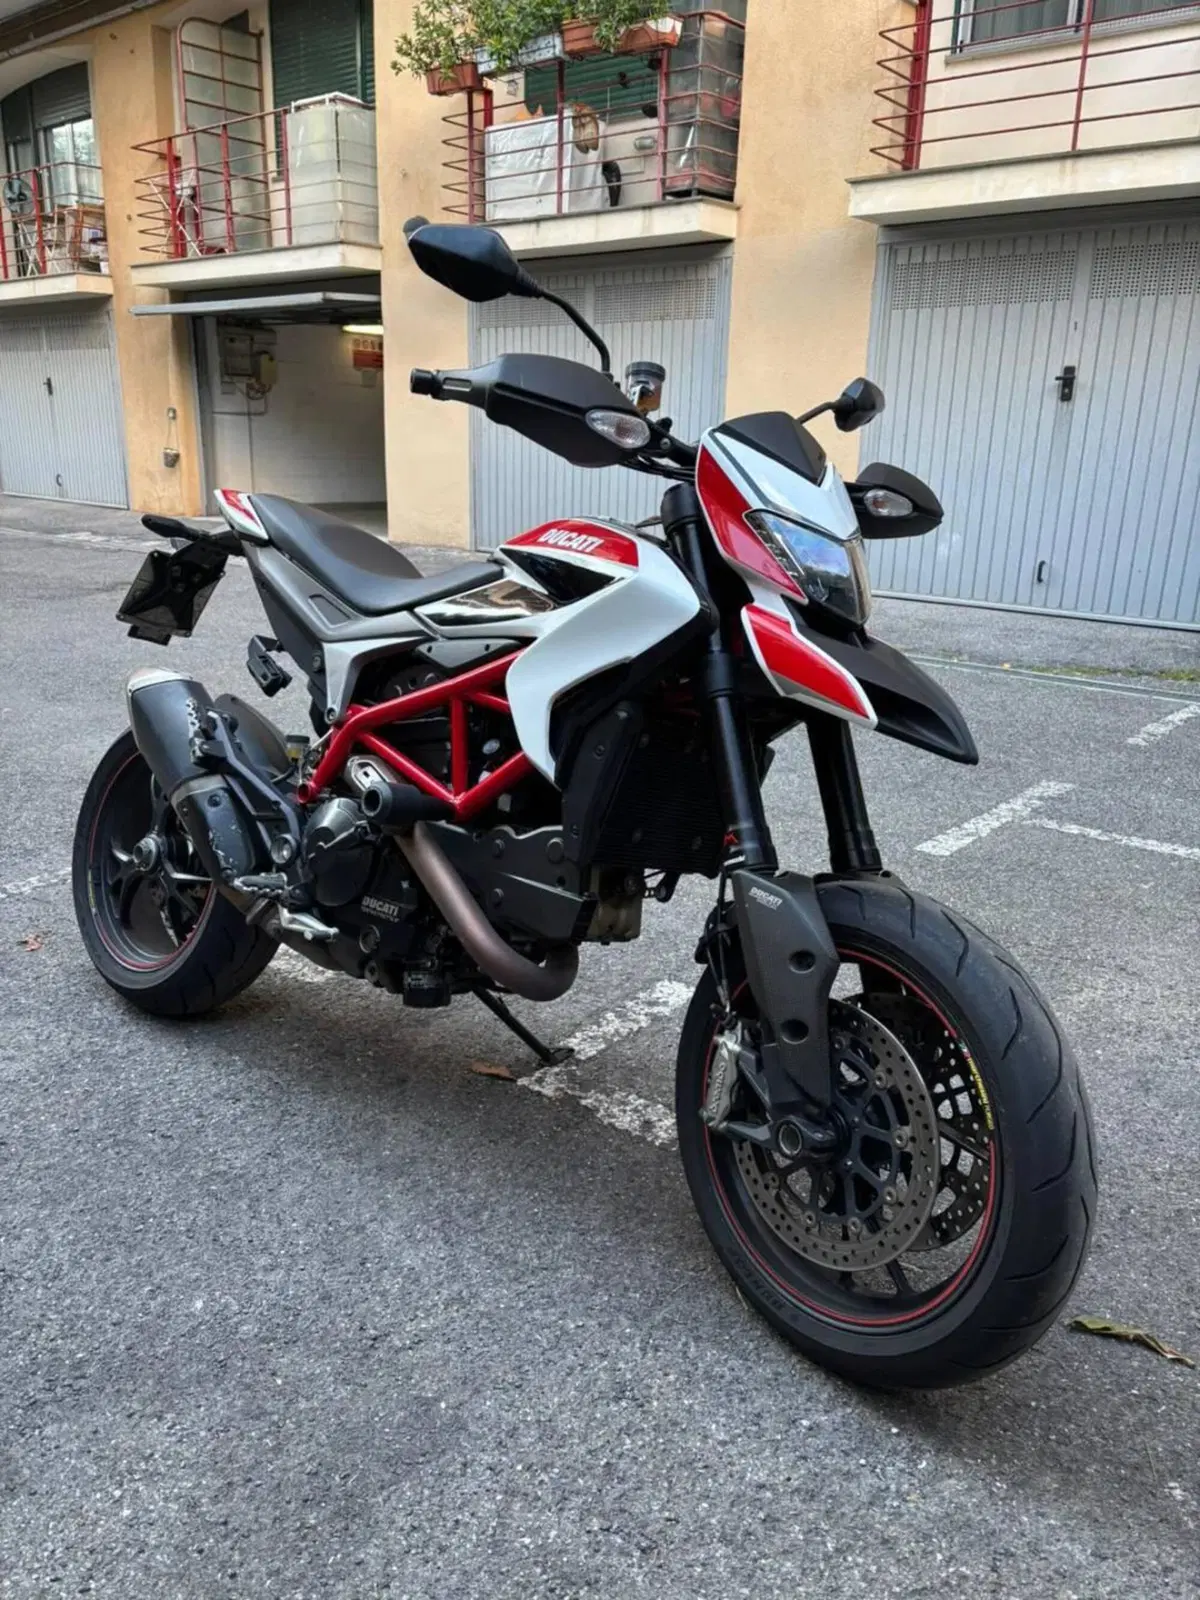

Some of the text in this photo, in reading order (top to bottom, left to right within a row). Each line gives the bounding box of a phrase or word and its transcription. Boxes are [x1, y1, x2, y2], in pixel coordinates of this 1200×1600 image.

[537, 529, 604, 552] DUCATI
[361, 895, 399, 916] DUCATI
[749, 886, 783, 907] DUCATI
